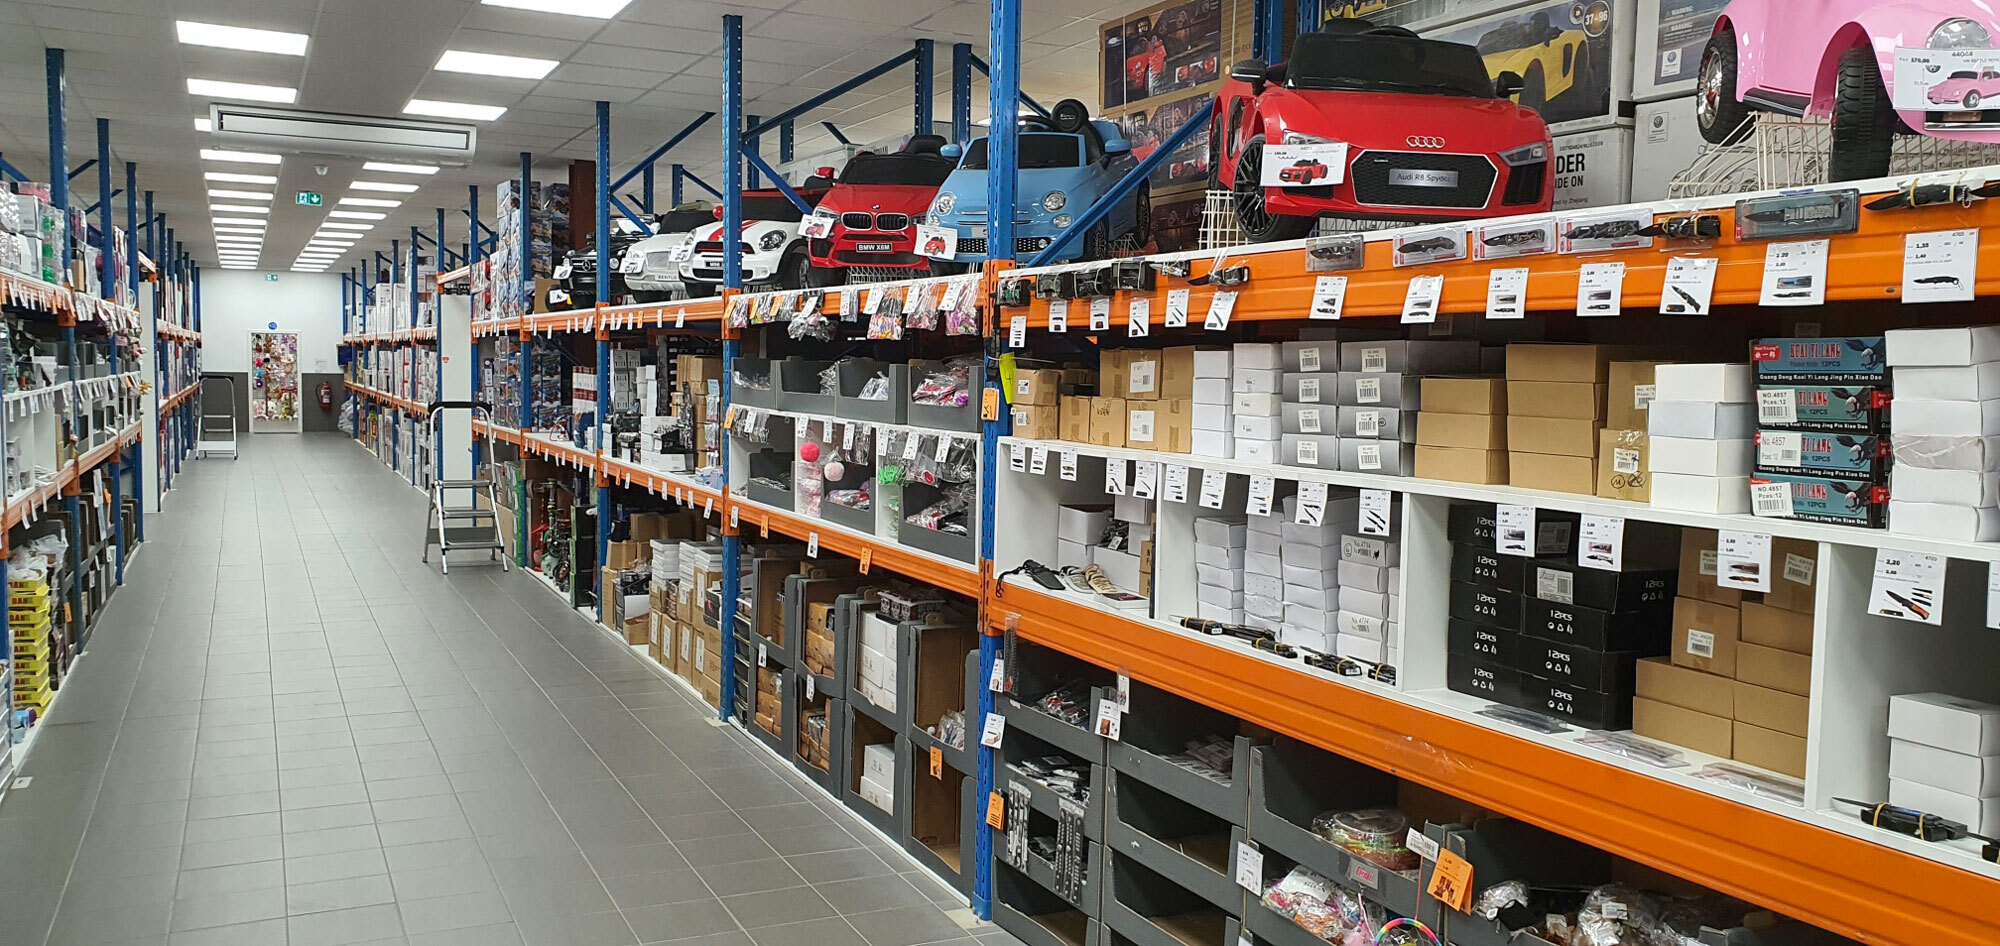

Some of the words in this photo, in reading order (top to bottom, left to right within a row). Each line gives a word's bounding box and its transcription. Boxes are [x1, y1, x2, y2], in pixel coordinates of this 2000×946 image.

[1556, 153, 1585, 174] DER
[1396, 173, 1413, 181] Audi
[1415, 173, 1425, 181] R8
[1426, 173, 1452, 183] Spyder
[1571, 175, 1584, 187] ON
[1477, 555, 1497, 566] 12PCS
[1477, 593, 1497, 604] 12PCS
[1550, 609, 1573, 621] 12PCS
[1476, 631, 1497, 643] 12PCS
[1548, 649, 1571, 662] 12PCS
[1474, 667, 1494, 679] 12PCS
[1550, 688, 1573, 701] 12PCS
